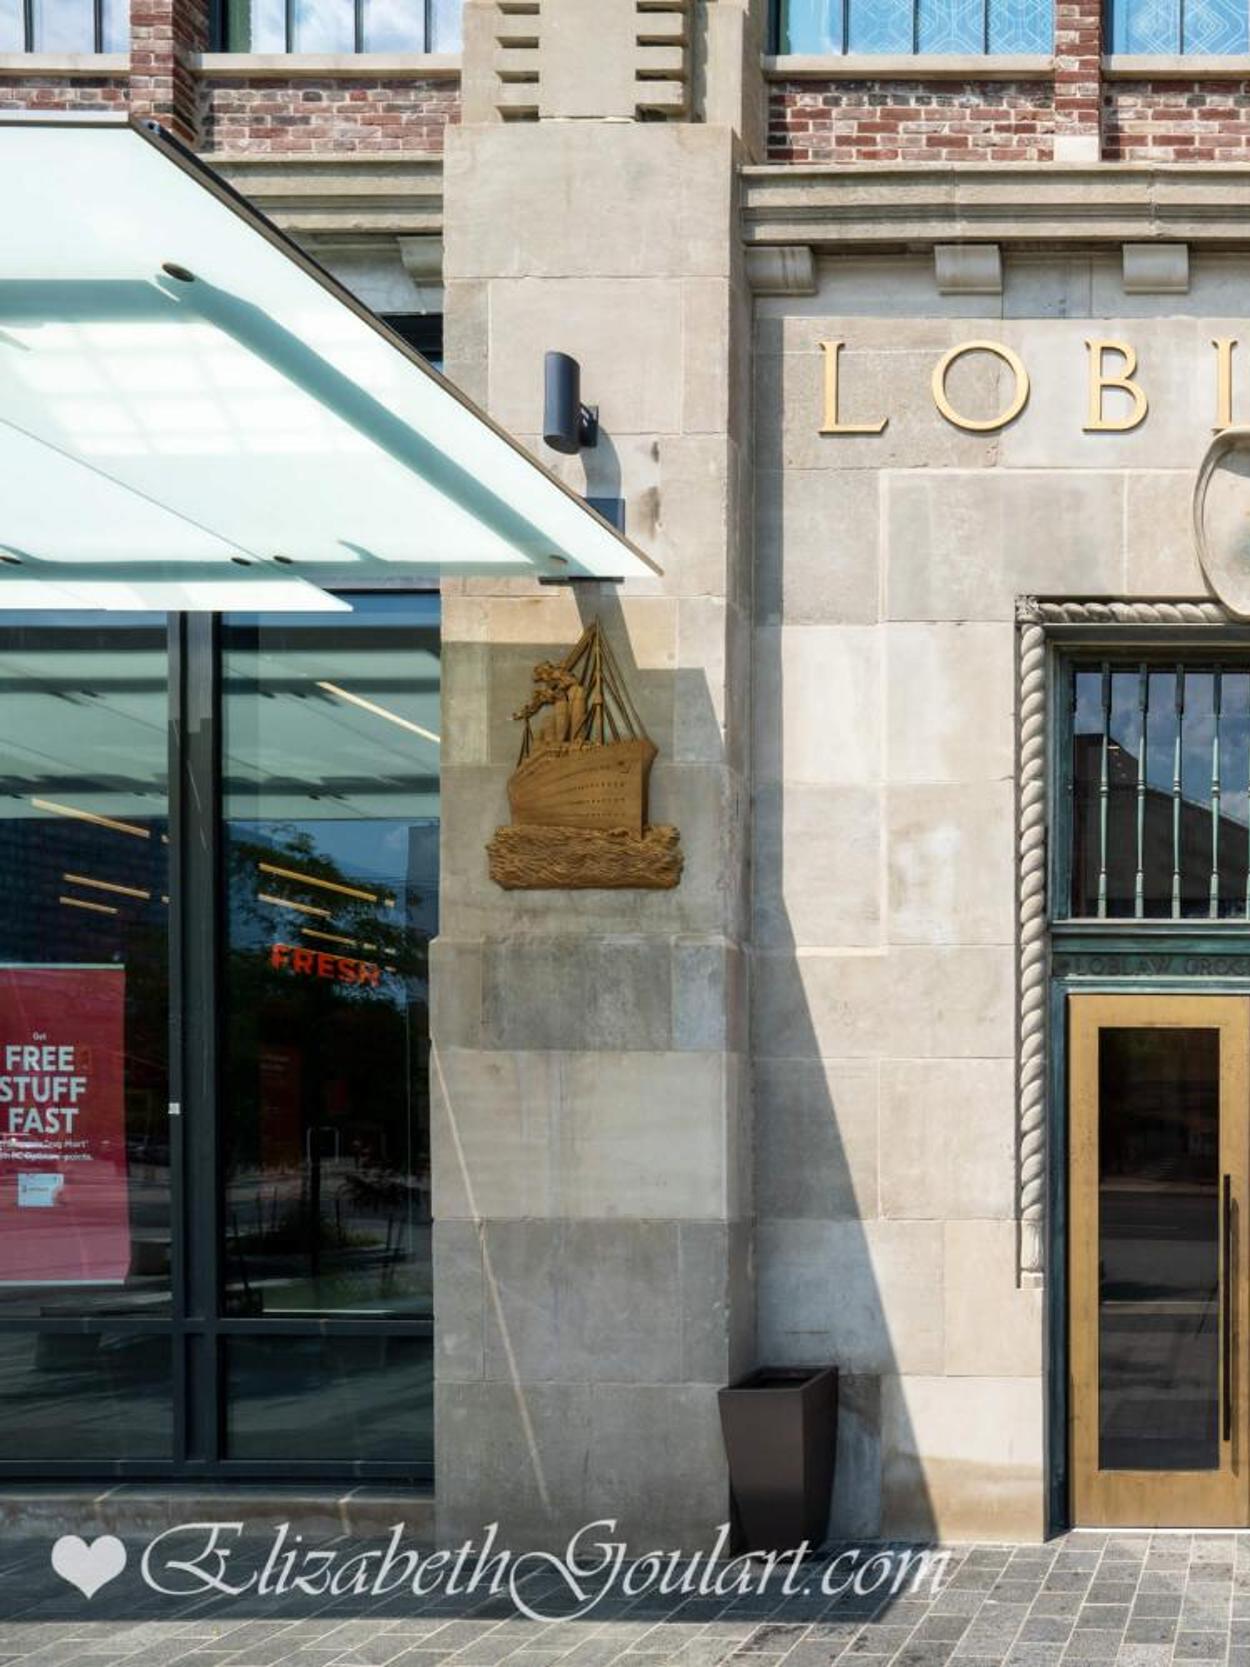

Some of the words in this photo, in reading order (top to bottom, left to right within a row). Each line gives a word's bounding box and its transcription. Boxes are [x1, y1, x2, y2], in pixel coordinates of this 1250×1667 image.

[271, 943, 380, 988] FRESH
[1071, 957, 1171, 977] LOBLAW
[33, 1032, 47, 1041] Get
[6, 1045, 75, 1072] FREE
[0, 1076, 87, 1103] STUFF
[9, 1108, 80, 1134] FAST
